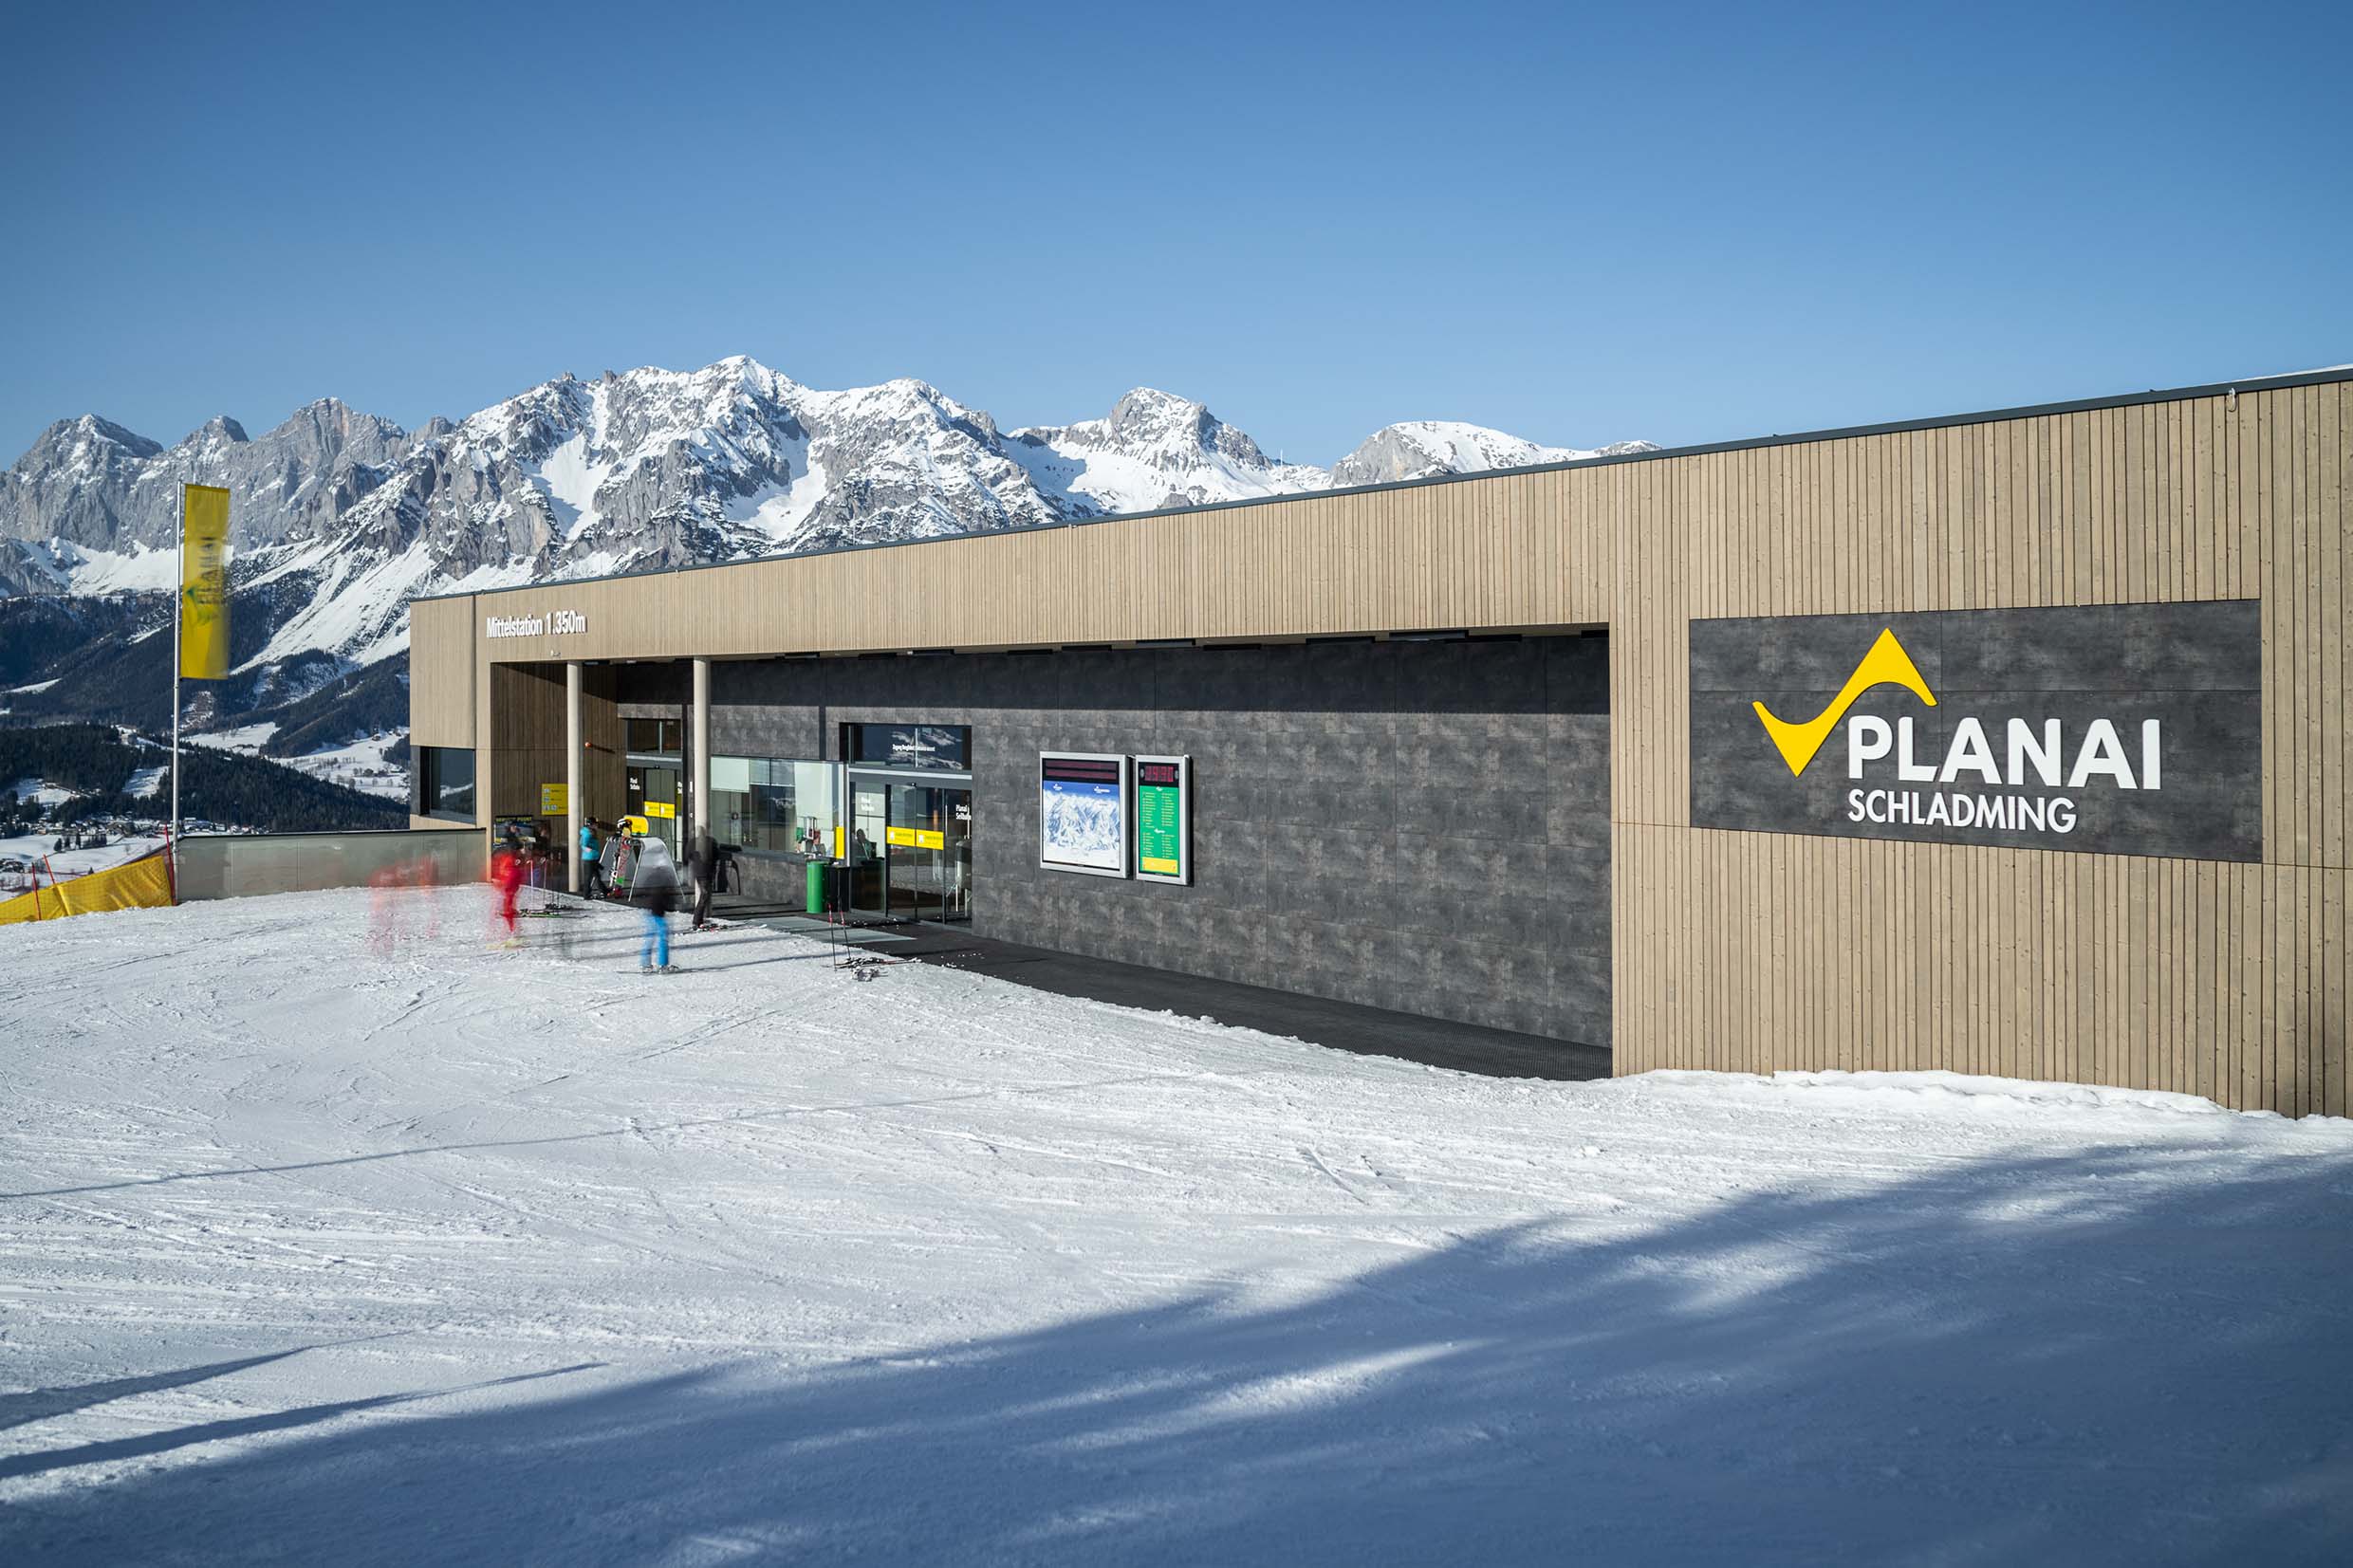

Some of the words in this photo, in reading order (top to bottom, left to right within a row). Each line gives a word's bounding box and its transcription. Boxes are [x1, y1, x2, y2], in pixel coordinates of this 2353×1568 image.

[486, 614, 544, 638] Mittelstation
[546, 610, 587, 636] 1.350m
[1847, 714, 2161, 790] PLANAI
[1847, 788, 2078, 834] SCHLADMING
